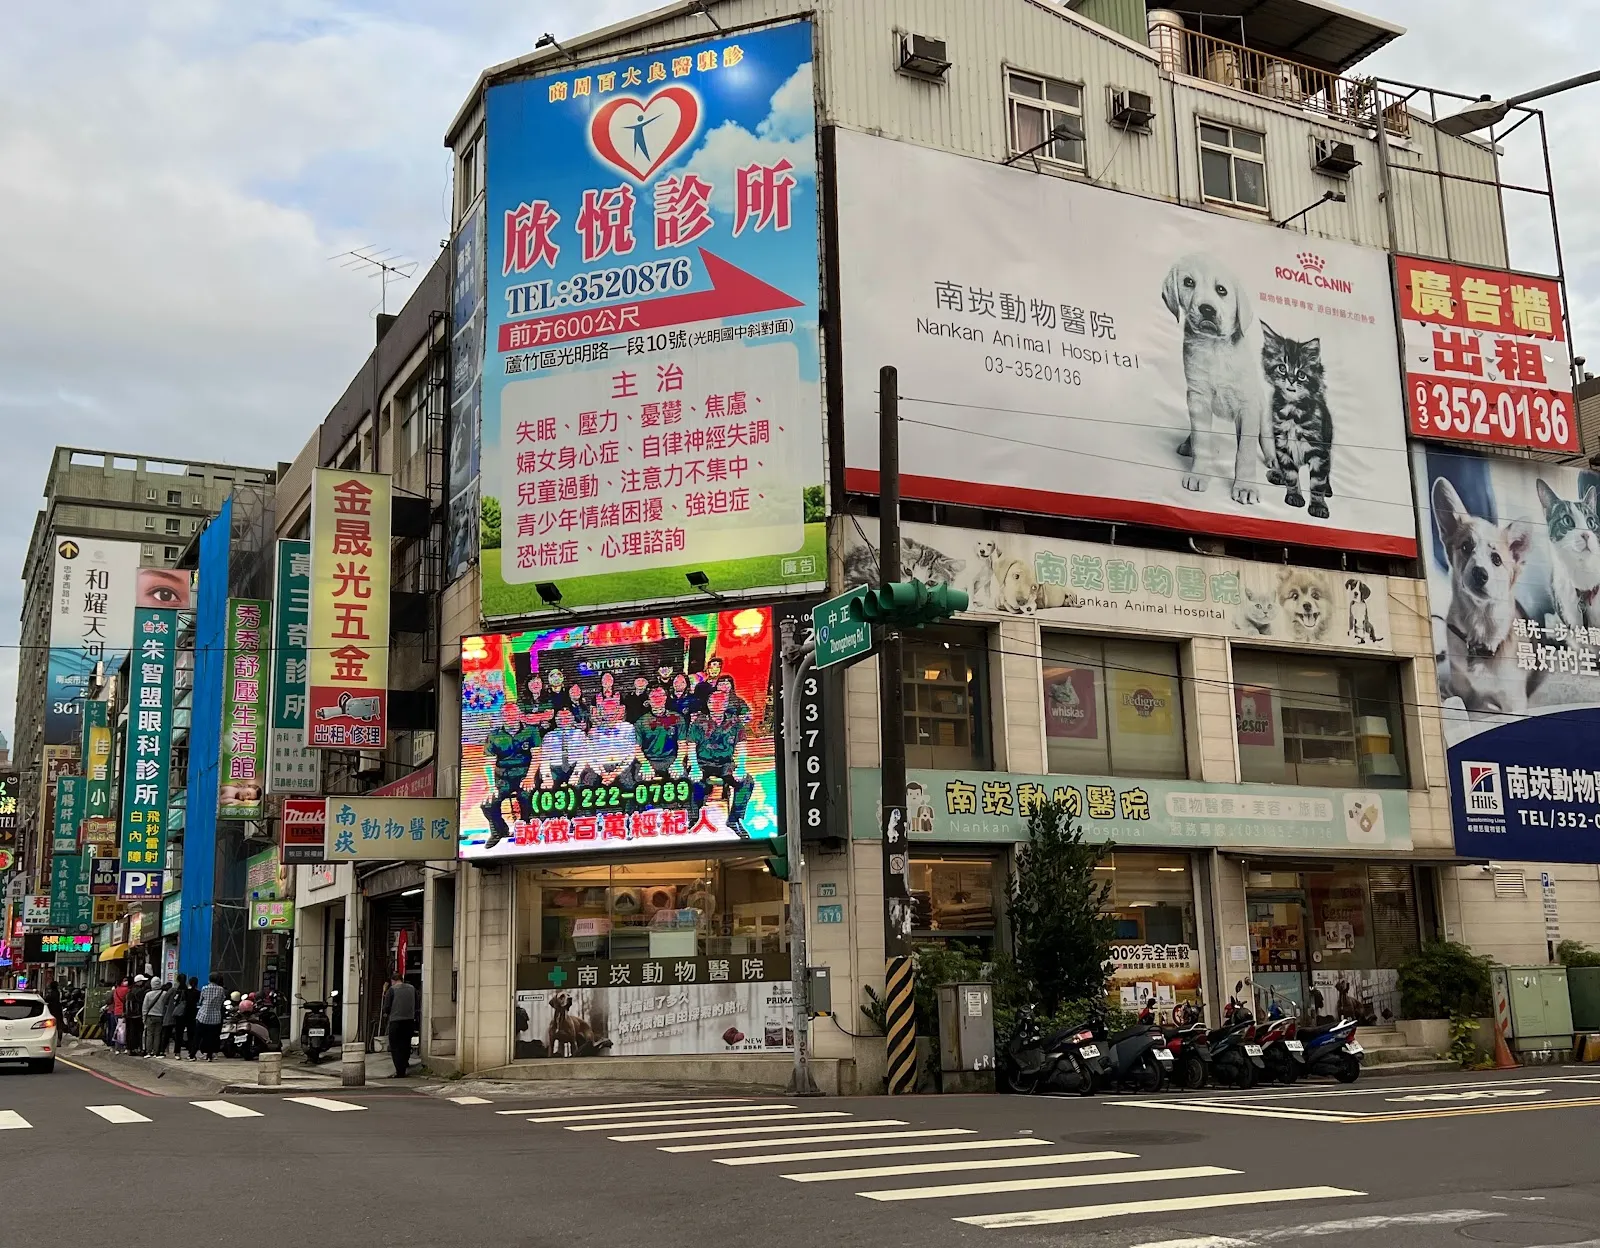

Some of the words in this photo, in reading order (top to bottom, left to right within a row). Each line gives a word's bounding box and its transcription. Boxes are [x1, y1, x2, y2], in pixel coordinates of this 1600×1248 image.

[549, 45, 744, 102] 商周百大良醫駐診
[502, 158, 797, 277] 欣悅診所
[507, 259, 690, 315] TEL:3520876
[1275, 266, 1313, 285] ROYAL
[1315, 275, 1351, 294] CANIN
[508, 306, 641, 348] 前方600公尺
[934, 279, 1116, 341] 南崁動物醫院
[504, 318, 795, 375] 蘆竹區光明路一段10號(光明國中斜對面)
[916, 318, 984, 344] Nankan
[993, 331, 1051, 355] Animal
[1062, 341, 1140, 370] Hospital
[1432, 331, 1547, 384] 出租
[611, 363, 684, 399] 主治
[984, 355, 1081, 387] 03-3520136
[1432, 384, 1569, 445] 352-0136
[517, 527, 685, 569] 恐慌症、心理諮詢
[783, 558, 814, 575] 廣告
[330, 479, 373, 682] 金晟光五金
[1034, 551, 1241, 605] 南崁動物醫院
[82, 568, 109, 661] 和耀天河
[142, 621, 168, 634] 台大
[828, 605, 851, 628] 中正
[1069, 594, 1118, 609] Nankan
[1125, 600, 1168, 614] Animal
[1173, 605, 1225, 620] Hospital
[283, 553, 310, 719] 黃三奇診所
[1517, 641, 1600, 677] 最好的生
[228, 604, 261, 780] 秀秀舒壓生活館
[1051, 706, 1084, 718] whiskas
[1122, 695, 1165, 709] Pedigree
[134, 639, 165, 805] 朱智盟眼科診所
[531, 789, 574, 812] (03)
[582, 781, 689, 807] 222-0789
[946, 779, 1150, 821] 南崁動物醫院
[1471, 795, 1498, 809] Hill's
[127, 811, 143, 863] 白內障
[144, 810, 160, 863] 飛秒雷射
[334, 804, 357, 854] 南崁
[360, 817, 451, 841] 動物醫院
[514, 808, 719, 846] 誠徵百萬經紀人
[950, 821, 1010, 833] Nankan
[577, 958, 765, 987] 南崁動物醫院
[1112, 946, 1190, 960] 00%完全無穀
